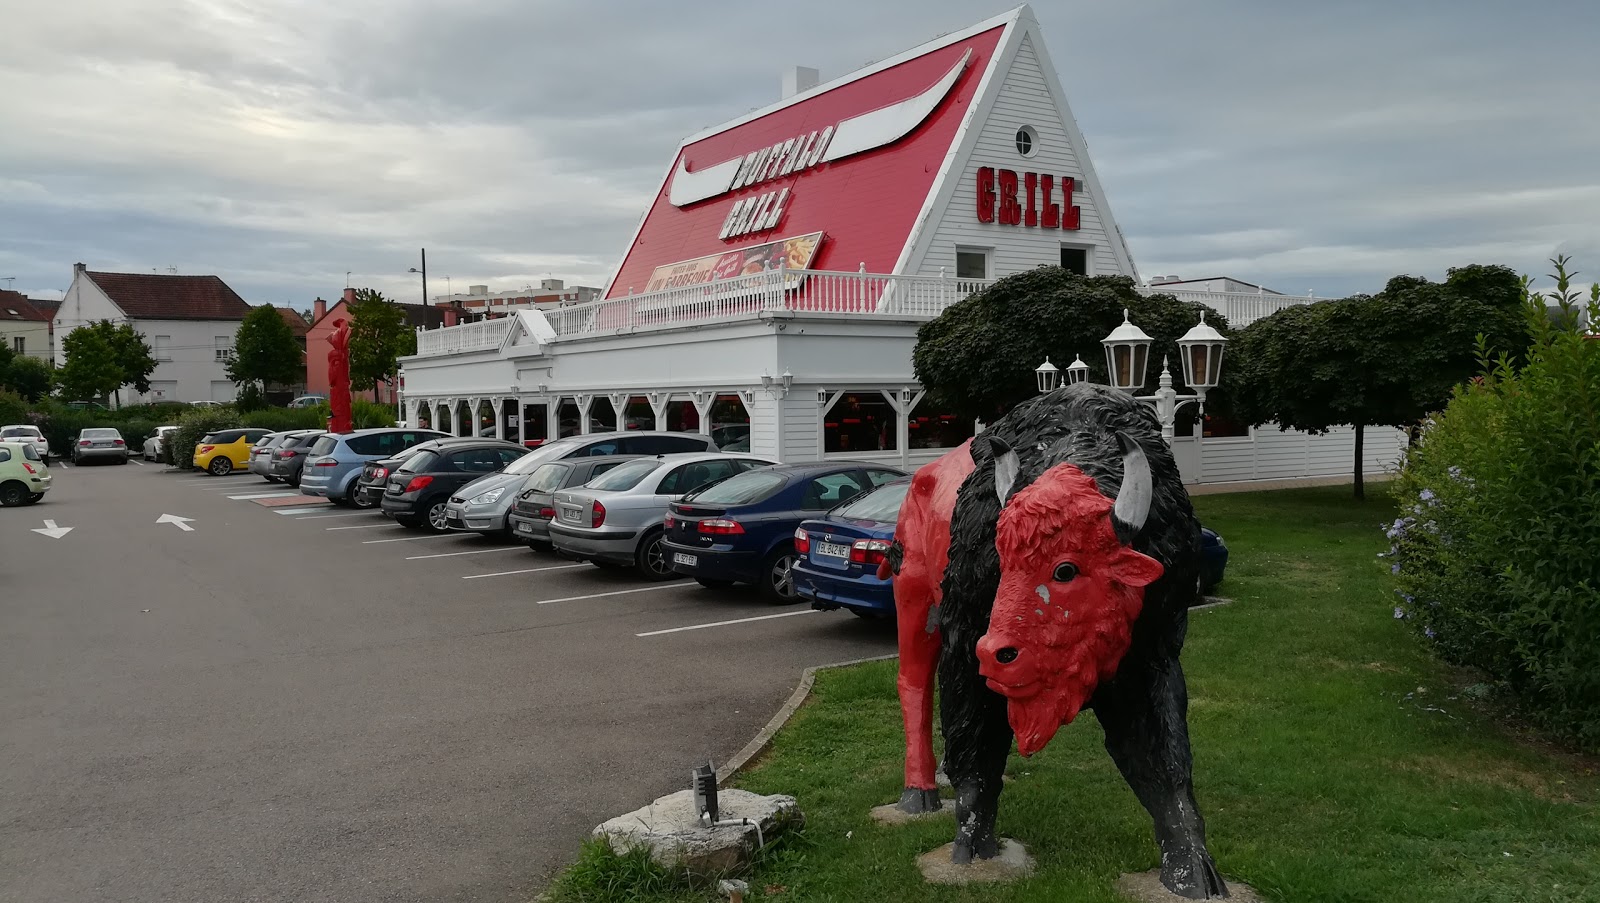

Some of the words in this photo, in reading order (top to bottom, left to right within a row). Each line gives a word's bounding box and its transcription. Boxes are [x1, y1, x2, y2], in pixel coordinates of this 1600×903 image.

[730, 125, 834, 191] BUFFALO
[718, 187, 789, 240] GRILL
[976, 166, 1081, 231] GRILL
